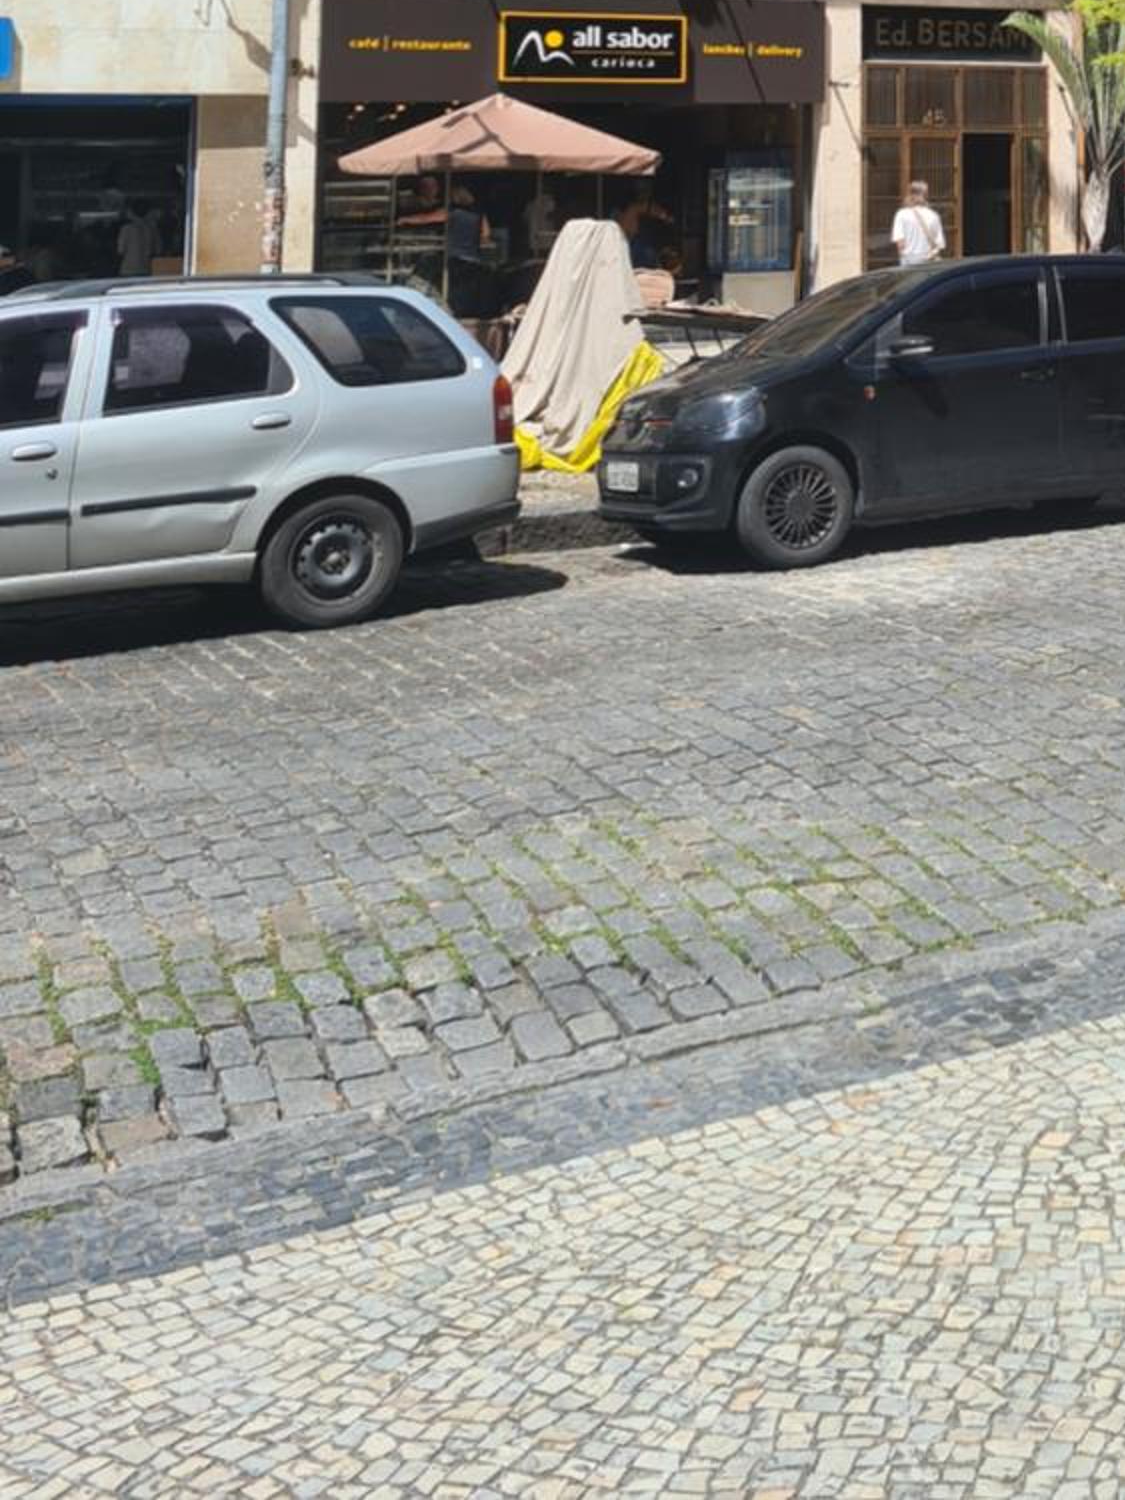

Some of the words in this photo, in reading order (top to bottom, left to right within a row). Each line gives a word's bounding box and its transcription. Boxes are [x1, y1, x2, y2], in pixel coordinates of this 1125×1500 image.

[572, 25, 601, 48] all
[607, 26, 673, 49] sabor
[391, 38, 472, 52] restaurante
[591, 56, 656, 69] carioca
